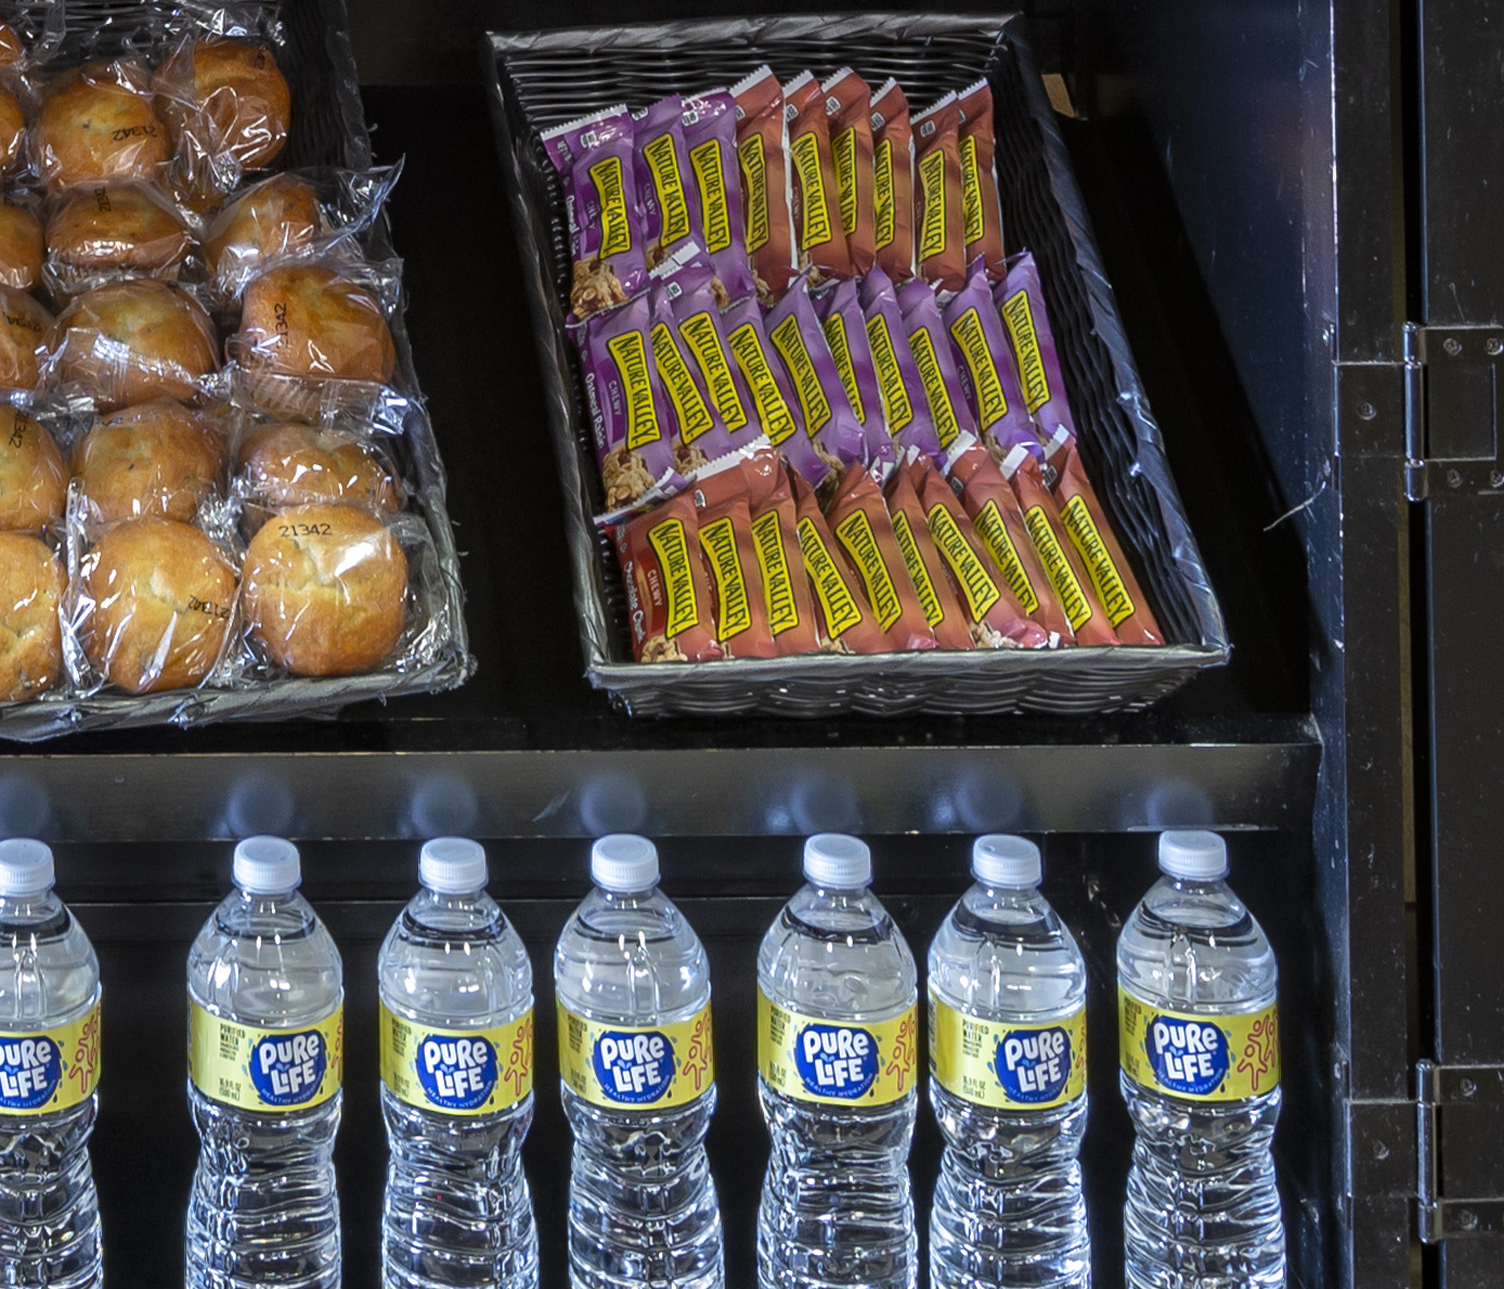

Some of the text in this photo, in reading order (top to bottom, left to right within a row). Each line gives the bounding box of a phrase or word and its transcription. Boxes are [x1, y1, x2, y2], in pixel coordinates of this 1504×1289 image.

[648, 137, 687, 239] NATURE VALLEY
[694, 144, 728, 246] NATURE VALLEY
[613, 335, 657, 441] NATURE VALLEY
[279, 523, 333, 538] 21342
[653, 524, 695, 629] NATURE VALLEY
